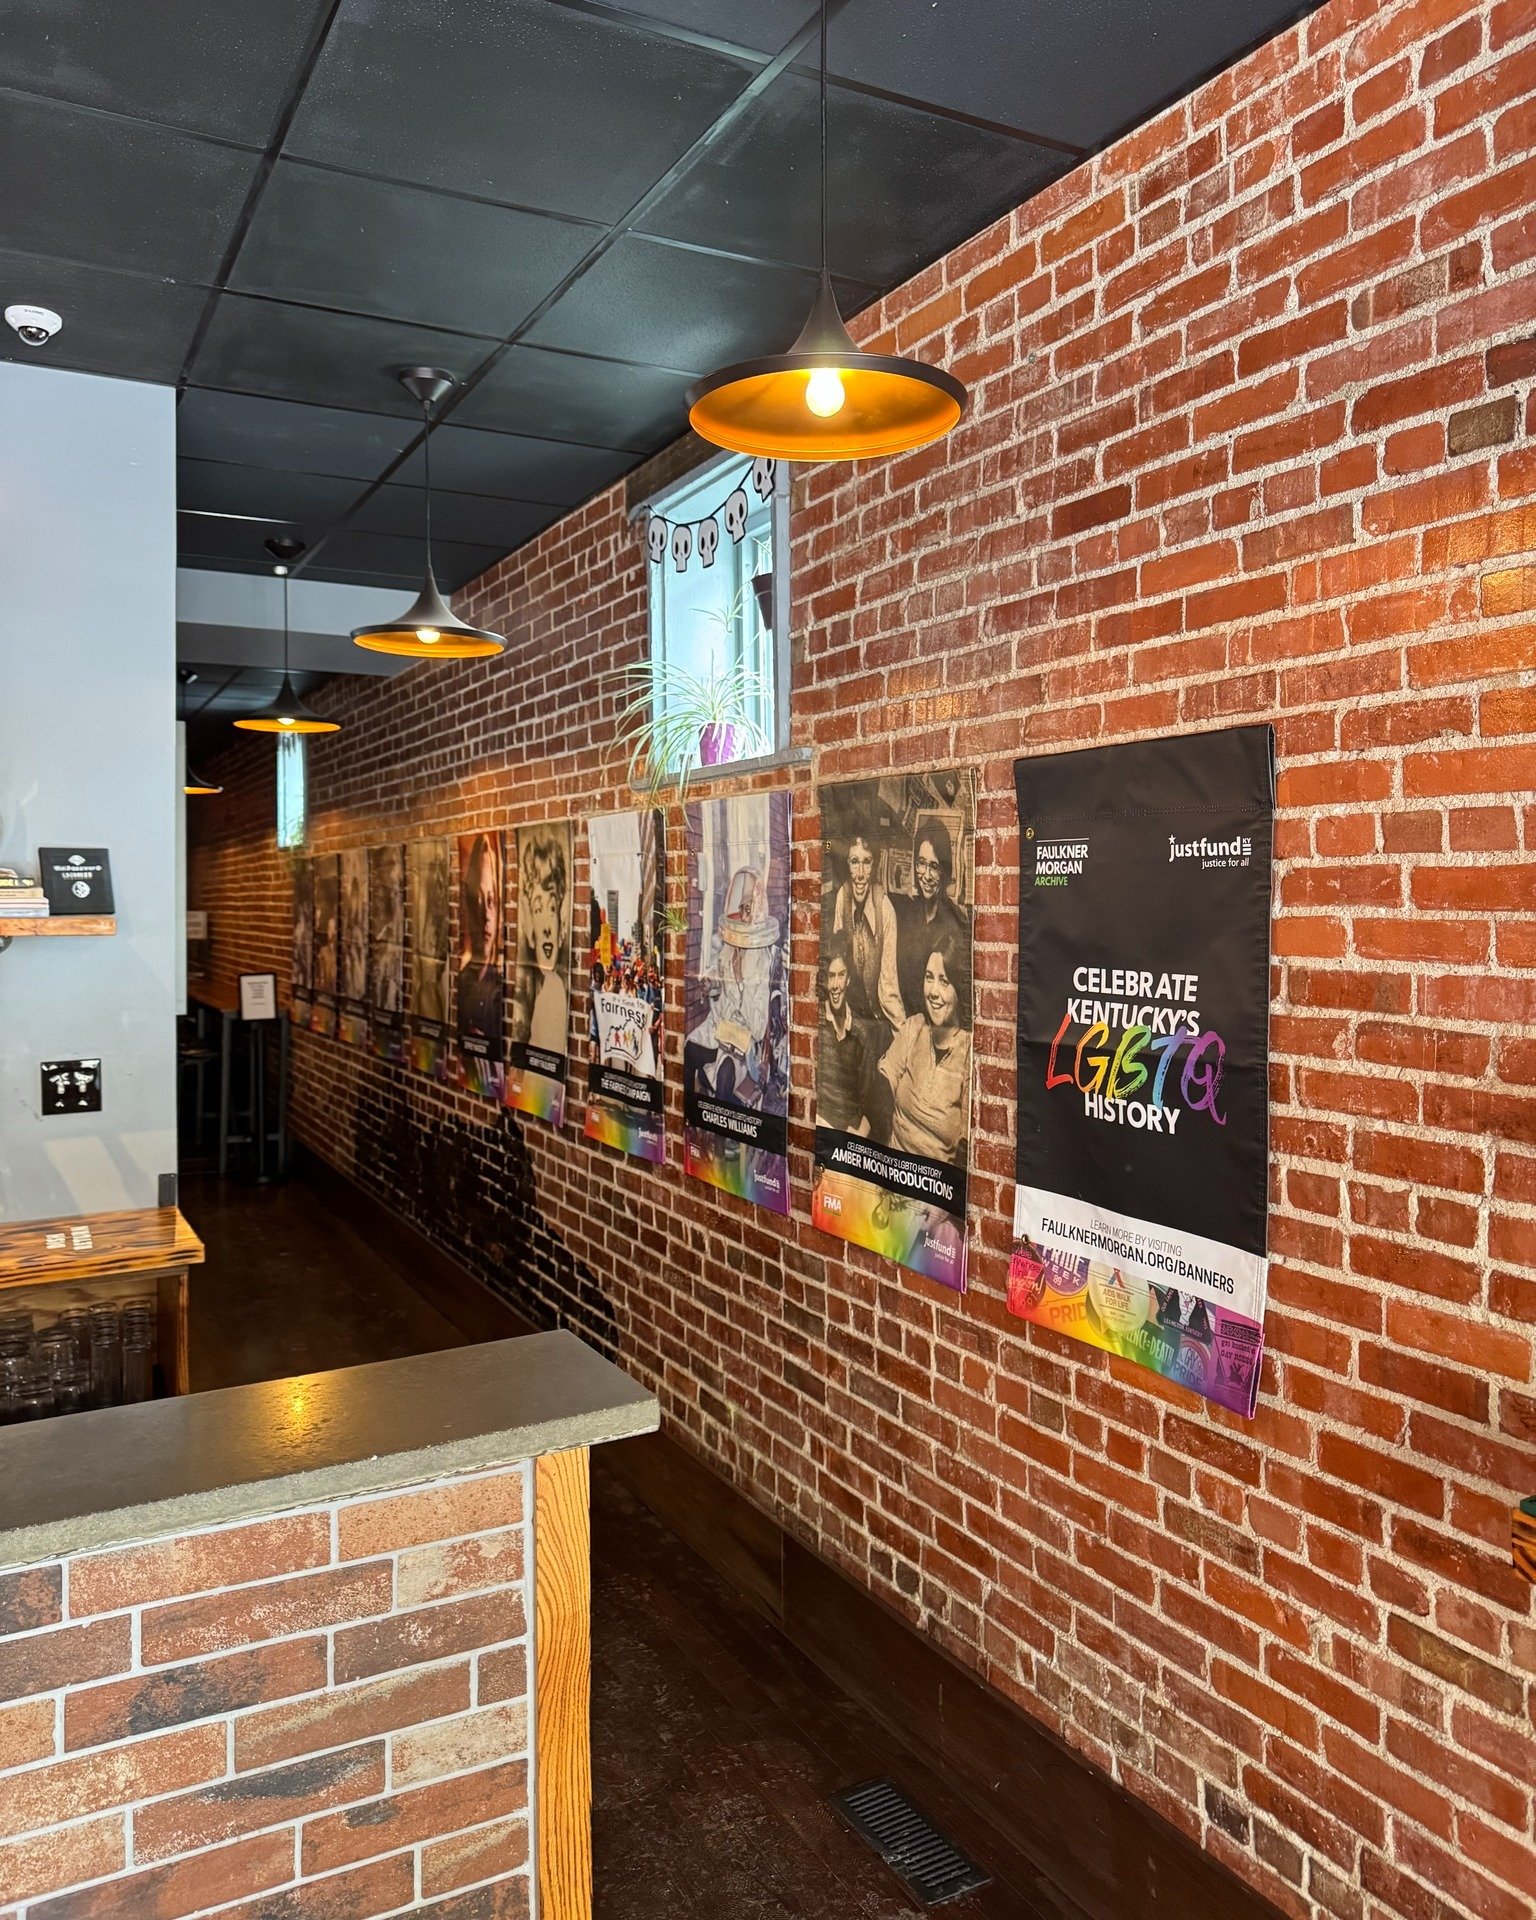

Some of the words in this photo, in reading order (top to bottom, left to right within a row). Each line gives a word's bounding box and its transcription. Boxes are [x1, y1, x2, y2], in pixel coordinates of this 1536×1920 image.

[1036, 844, 1089, 860] FAULKNER
[1168, 834, 1240, 862] justfund
[1035, 860, 1083, 875] MORGAN
[1202, 858, 1226, 870] justice
[1228, 857, 1239, 867] for
[1240, 857, 1250, 867] all
[1034, 876, 1068, 886] ARCHIVE
[1072, 966, 1199, 1002] CELEBRATE
[1067, 998, 1201, 1037] KENTUCKY'S
[1044, 1013, 1227, 1126] LGBTQ
[702, 1110, 728, 1128] CHARLES
[728, 1117, 758, 1138] WILLIAMS
[1084, 1091, 1181, 1135] HISTORY
[831, 1147, 862, 1168] AMBER
[863, 1156, 888, 1179] MOON
[889, 1166, 954, 1201] PRODUCTIONS
[898, 1160, 918, 1174] LGBTQ
[918, 1165, 943, 1179] HISTORY
[823, 1195, 842, 1213] FMA
[1090, 1218, 1112, 1235] LEARN
[1112, 1226, 1134, 1244] MORE
[1134, 1233, 1147, 1247] BY
[1147, 1236, 1183, 1257] VISITING
[1041, 1217, 1235, 1295] FAULKNERMORGAN.ORG/BANNERS
[1042, 1258, 1080, 1287] WEEK
